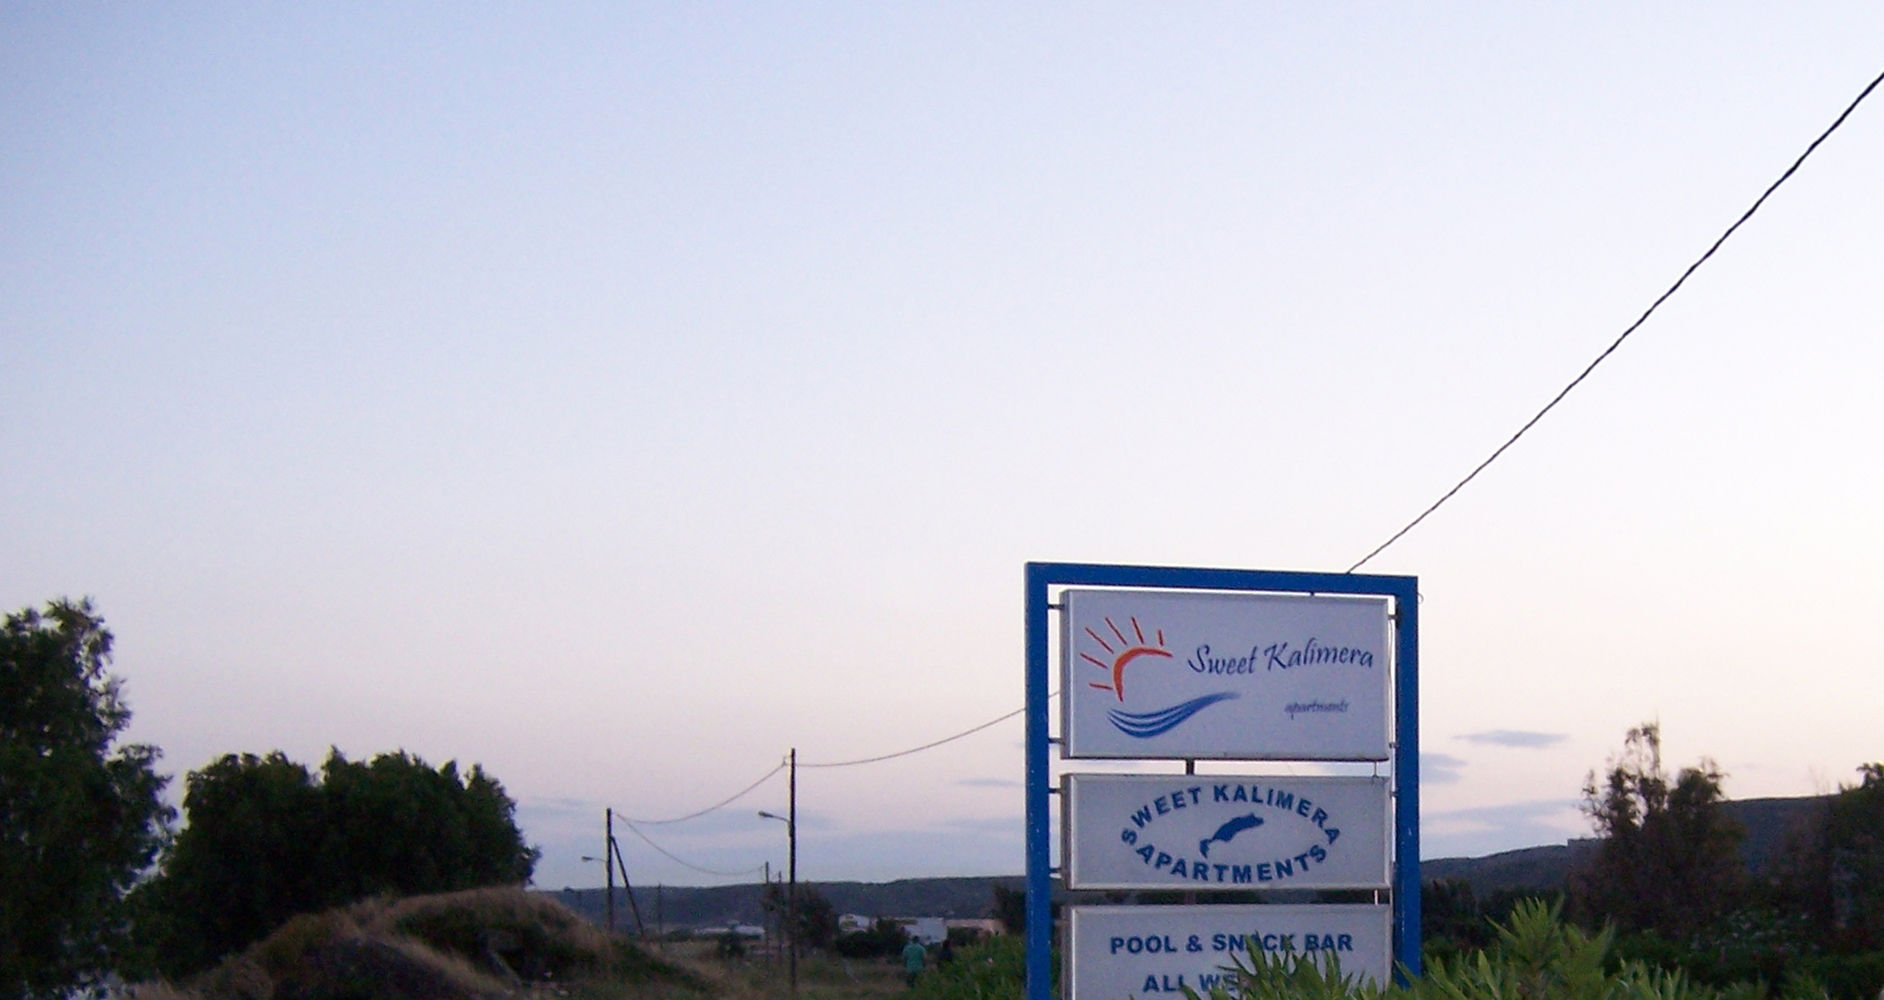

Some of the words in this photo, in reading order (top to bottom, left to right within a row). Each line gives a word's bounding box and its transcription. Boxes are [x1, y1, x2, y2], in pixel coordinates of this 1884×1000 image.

[1187, 644, 1257, 675] Sweet
[1264, 637, 1375, 671] Kalimera
[1121, 786, 1202, 846] SWEET
[1214, 784, 1341, 845] KALIMERA
[1136, 843, 1327, 884] APARTMENTS
[1110, 935, 1176, 954] POOL
[1186, 934, 1203, 953] &
[1305, 933, 1353, 951] BAR
